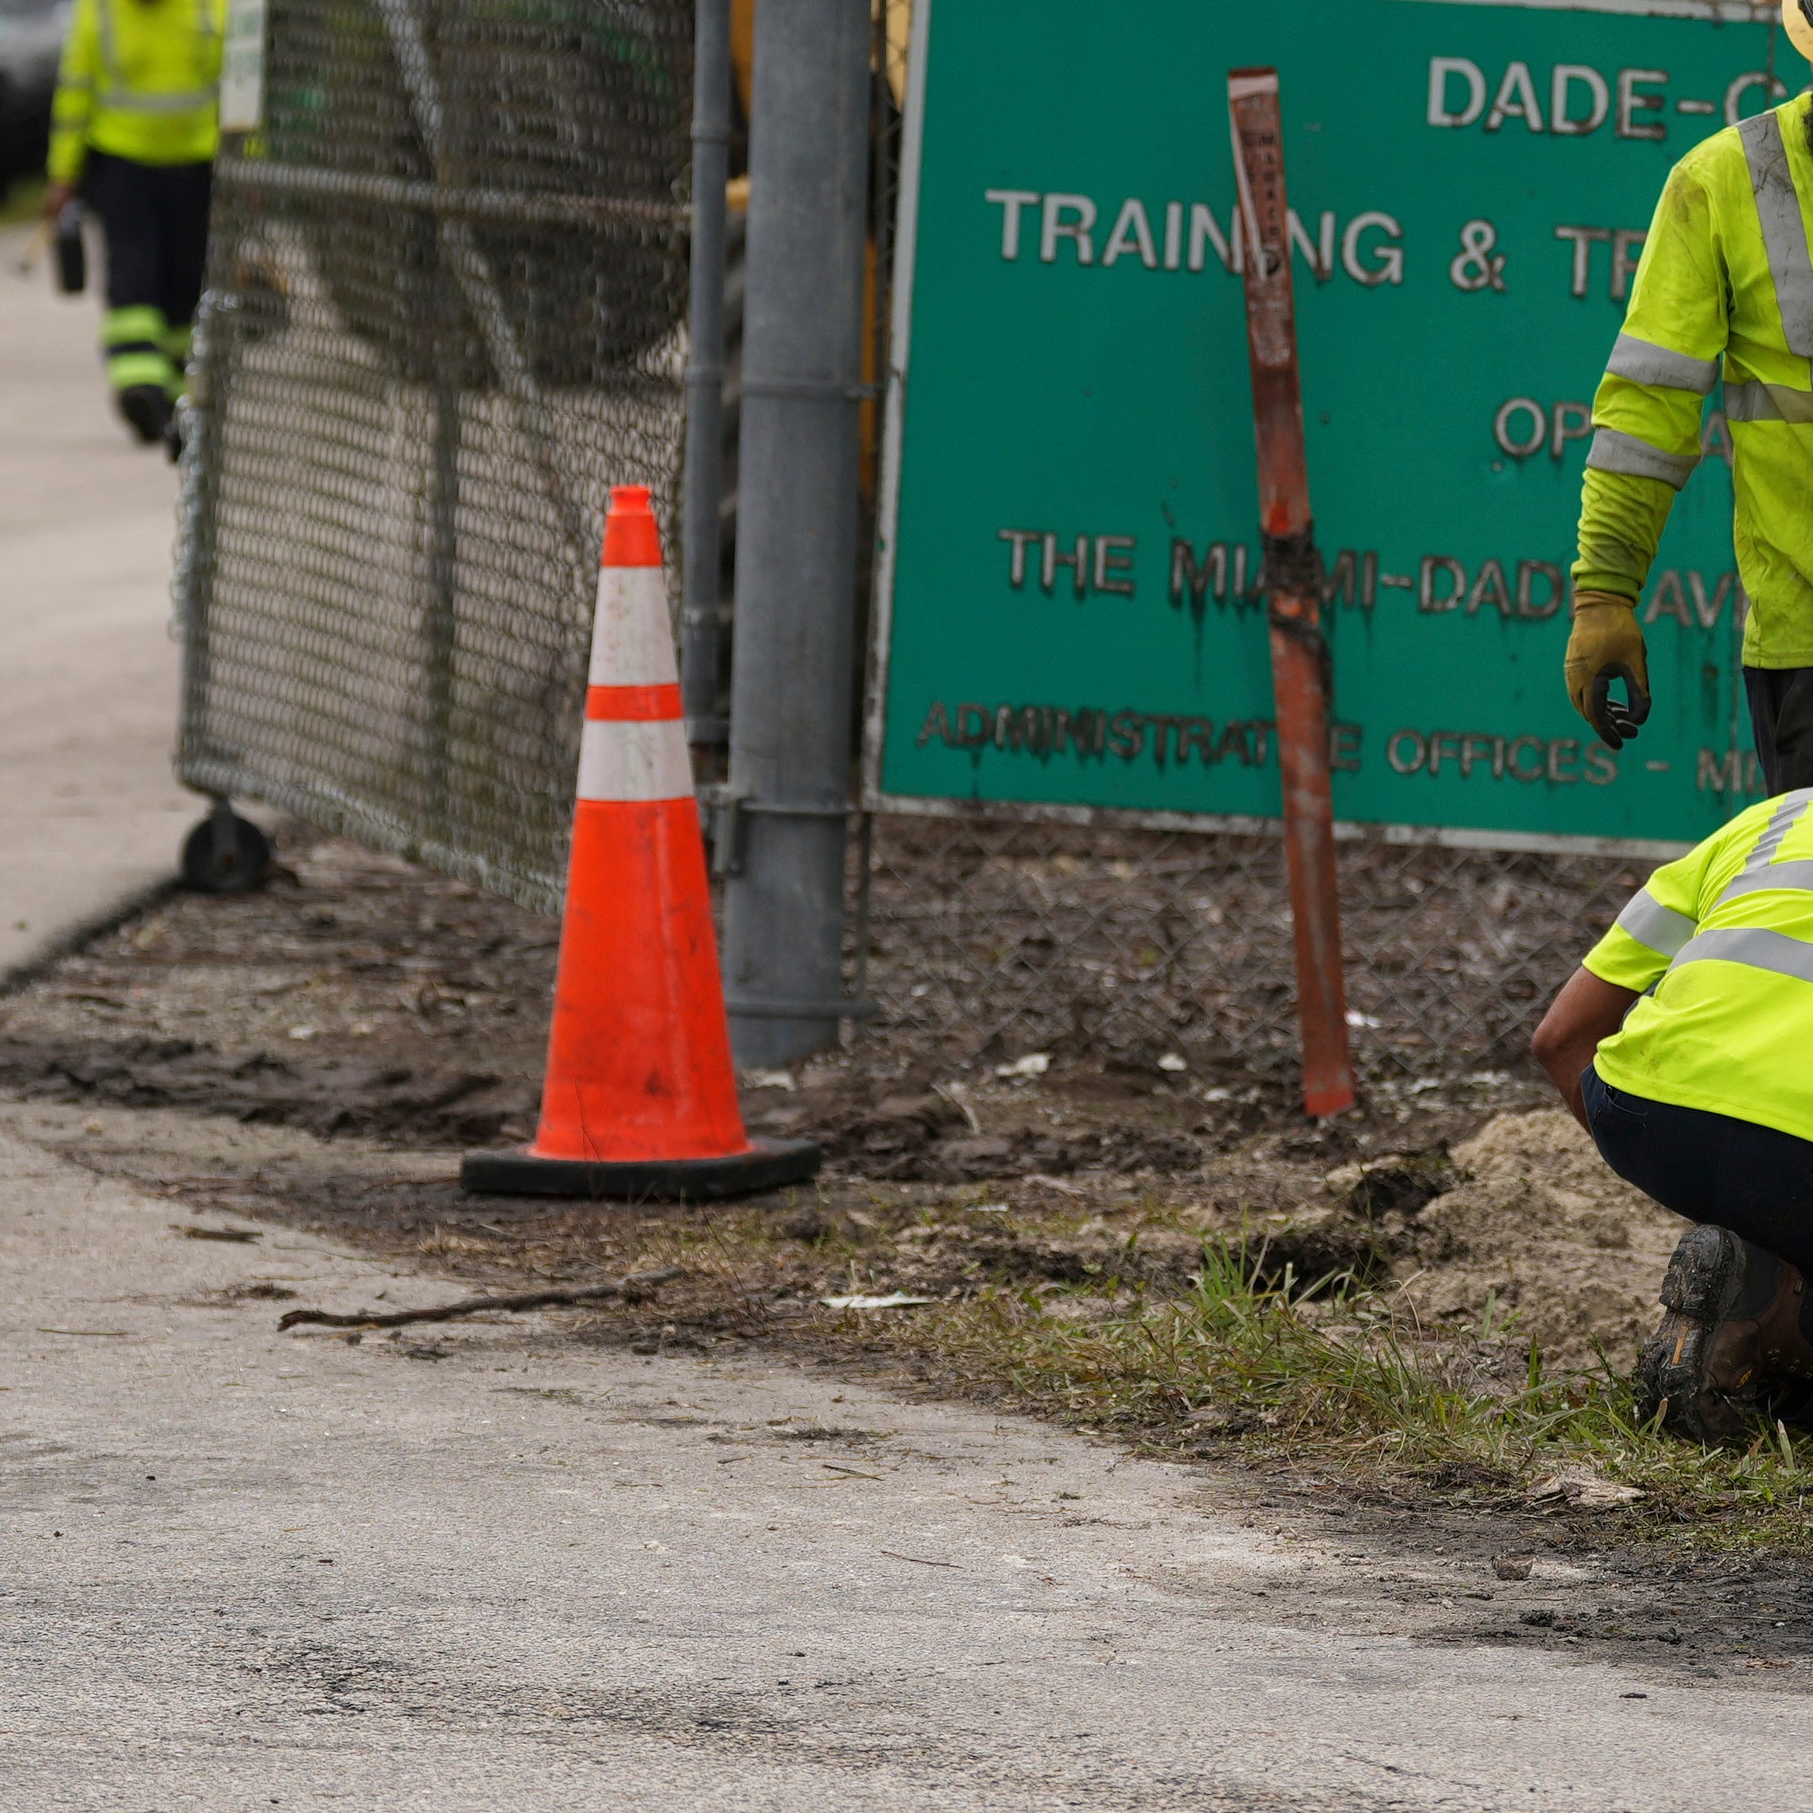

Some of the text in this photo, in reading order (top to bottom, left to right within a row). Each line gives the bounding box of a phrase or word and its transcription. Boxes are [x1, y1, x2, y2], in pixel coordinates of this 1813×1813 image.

[1426, 56, 1788, 141] DADE-C
[985, 187, 1404, 286] TRAINNG
[1449, 219, 1507, 293] &
[998, 527, 1137, 596] THE
[1170, 536, 1576, 622] MIMI-DAD
[916, 701, 1364, 773] ADMINISTRATE
[1387, 728, 1620, 786] OFFICES
